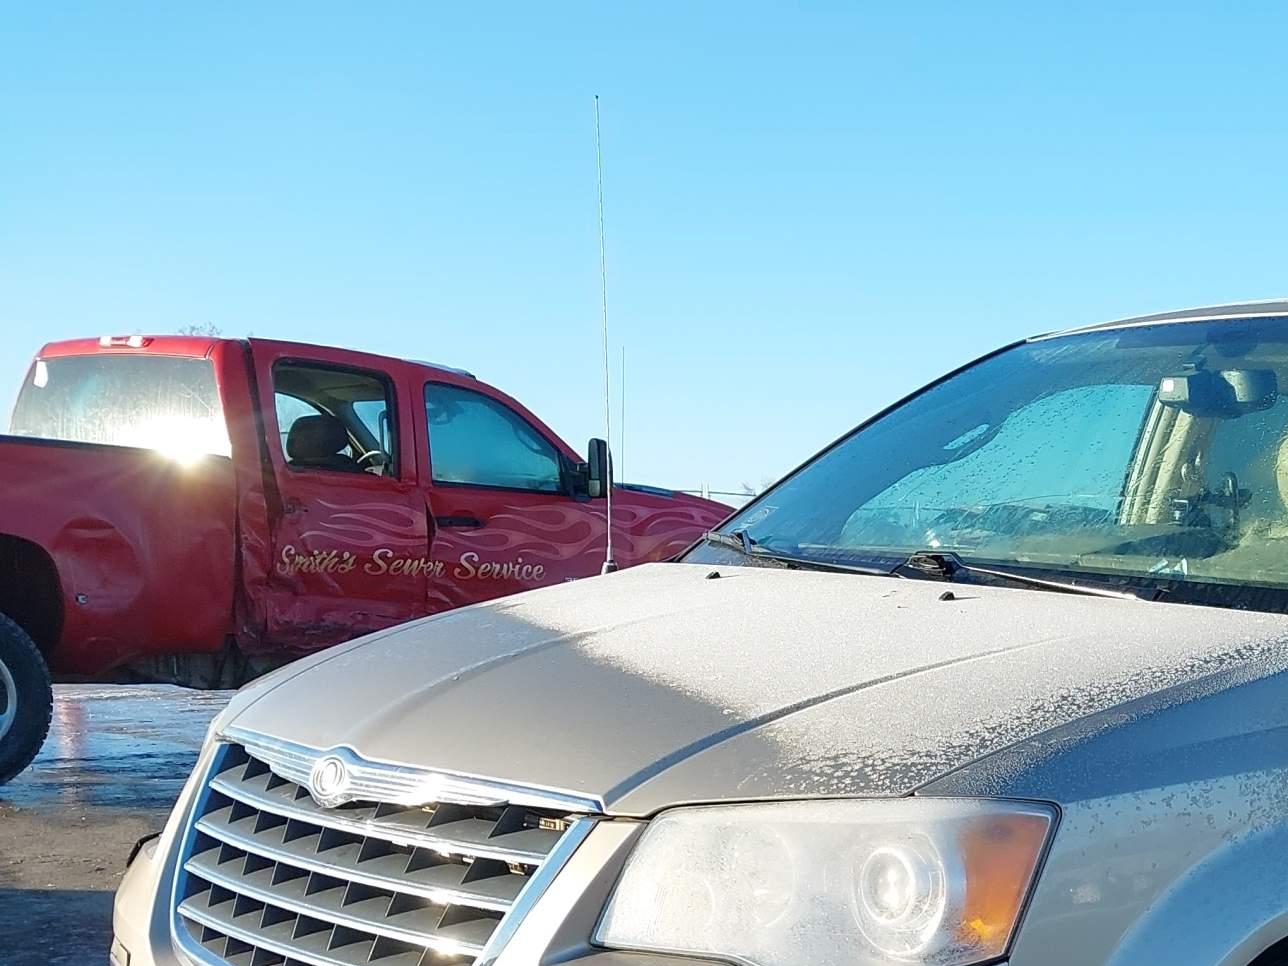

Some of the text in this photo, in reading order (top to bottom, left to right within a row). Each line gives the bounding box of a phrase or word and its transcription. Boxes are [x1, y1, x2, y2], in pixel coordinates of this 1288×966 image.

[277, 544, 546, 582] Smith's Sewer Service
